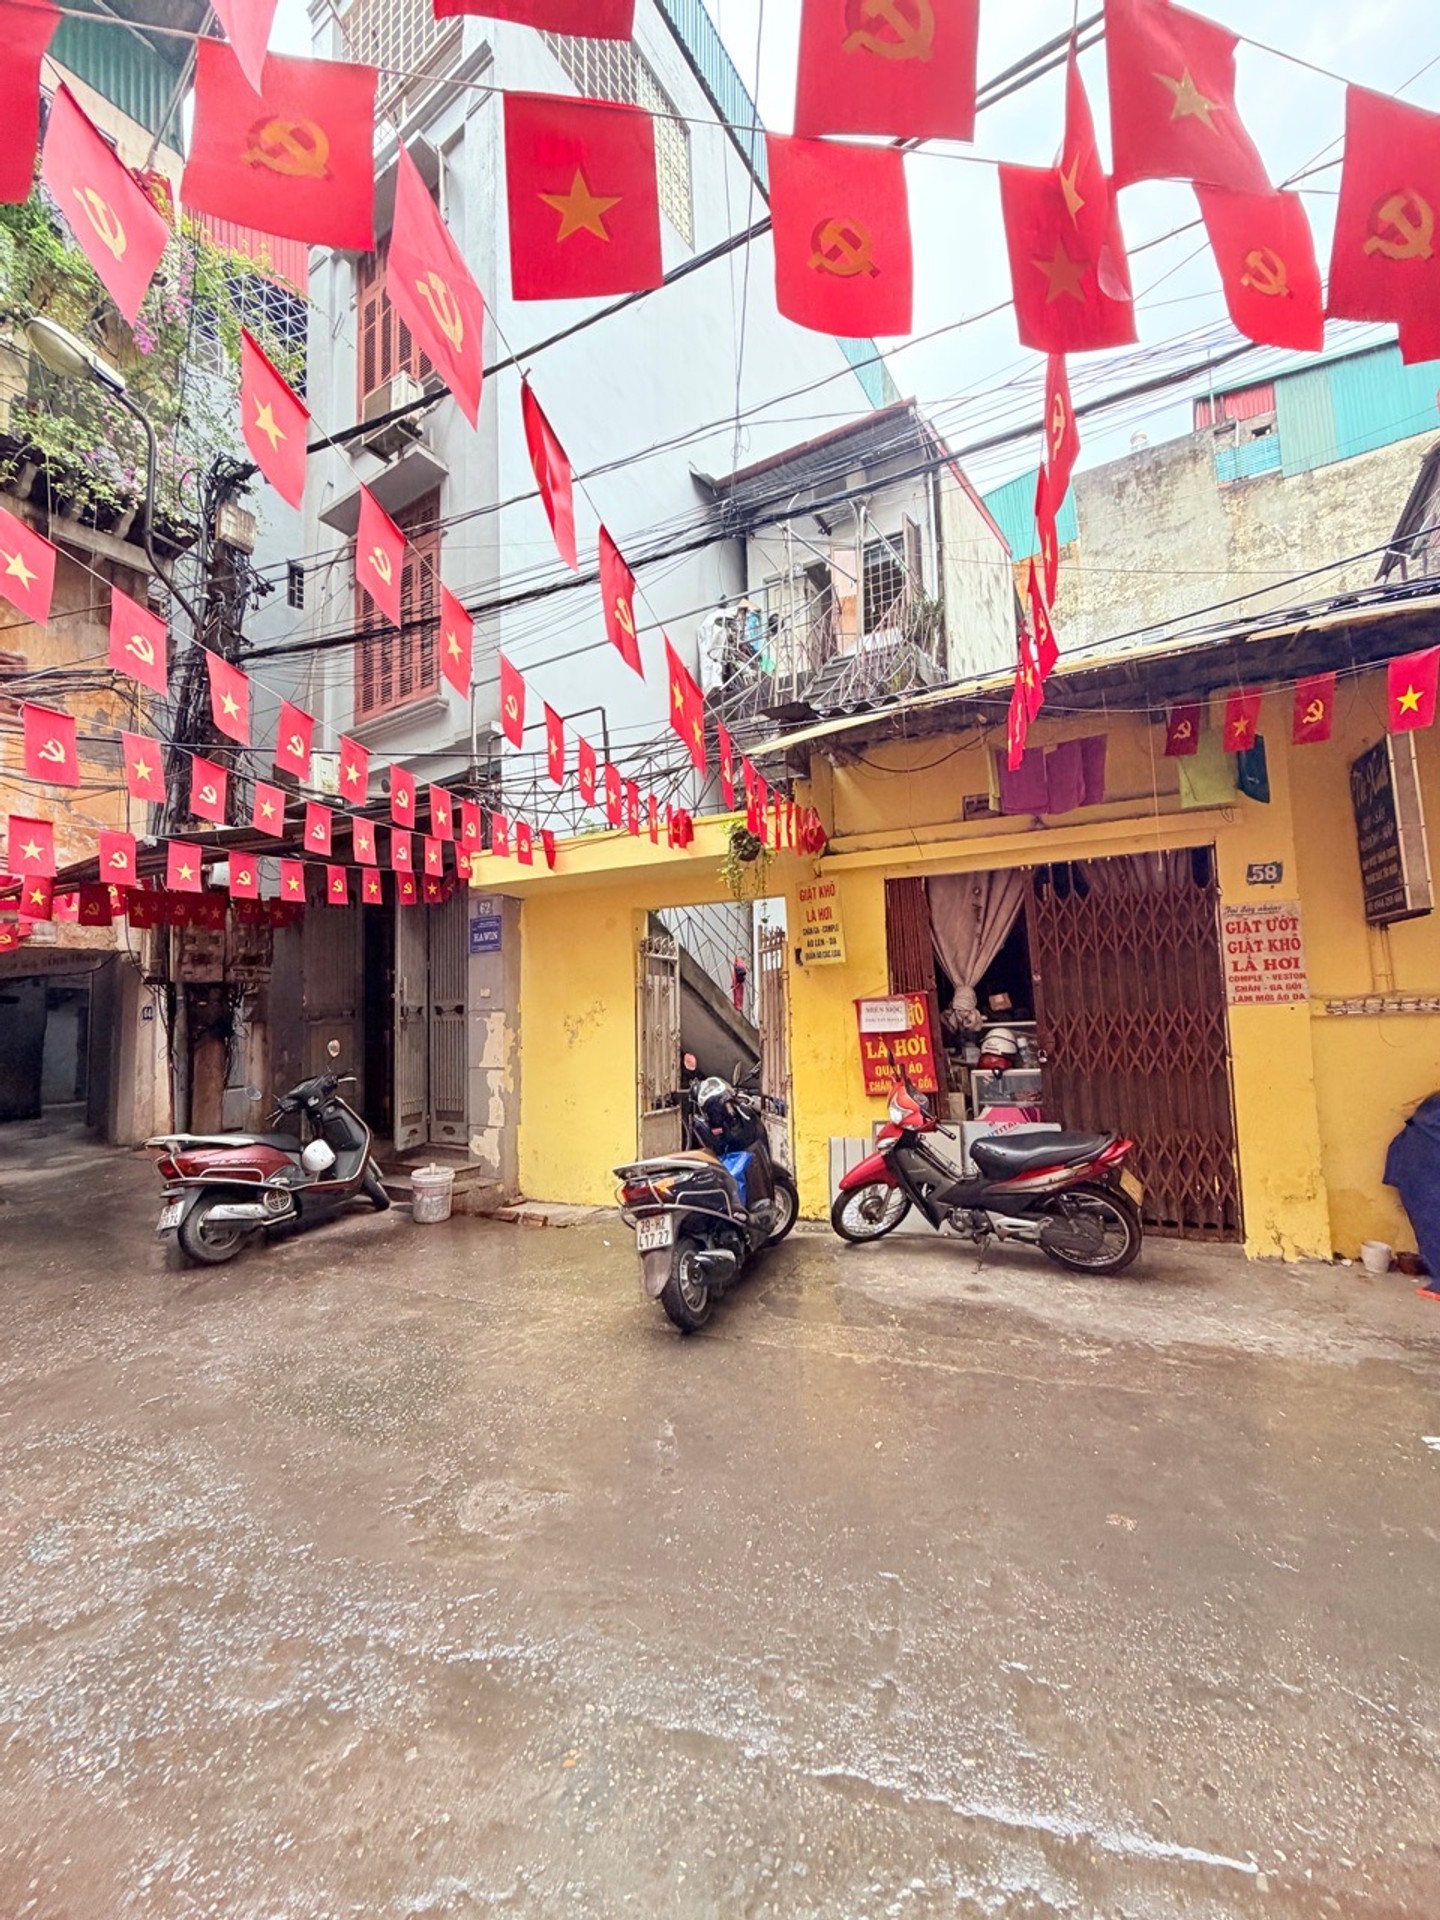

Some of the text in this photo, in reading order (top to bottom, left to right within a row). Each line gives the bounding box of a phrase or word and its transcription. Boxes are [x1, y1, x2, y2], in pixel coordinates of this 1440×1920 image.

[1248, 865, 1277, 881] 58
[819, 881, 836, 898] KHÔ
[806, 906, 832, 923] LÀ HƠI
[1225, 913, 1298, 936] GIẶT ƯỚT
[1227, 933, 1301, 956] GIẶT KHÔ
[1232, 954, 1300, 972] LÀ HƠI
[1272, 972, 1307, 981] VESTON
[865, 1034, 928, 1058] LÀ HƠI
[909, 1061, 923, 1074] ÁO
[918, 1074, 932, 1089] GỐI
